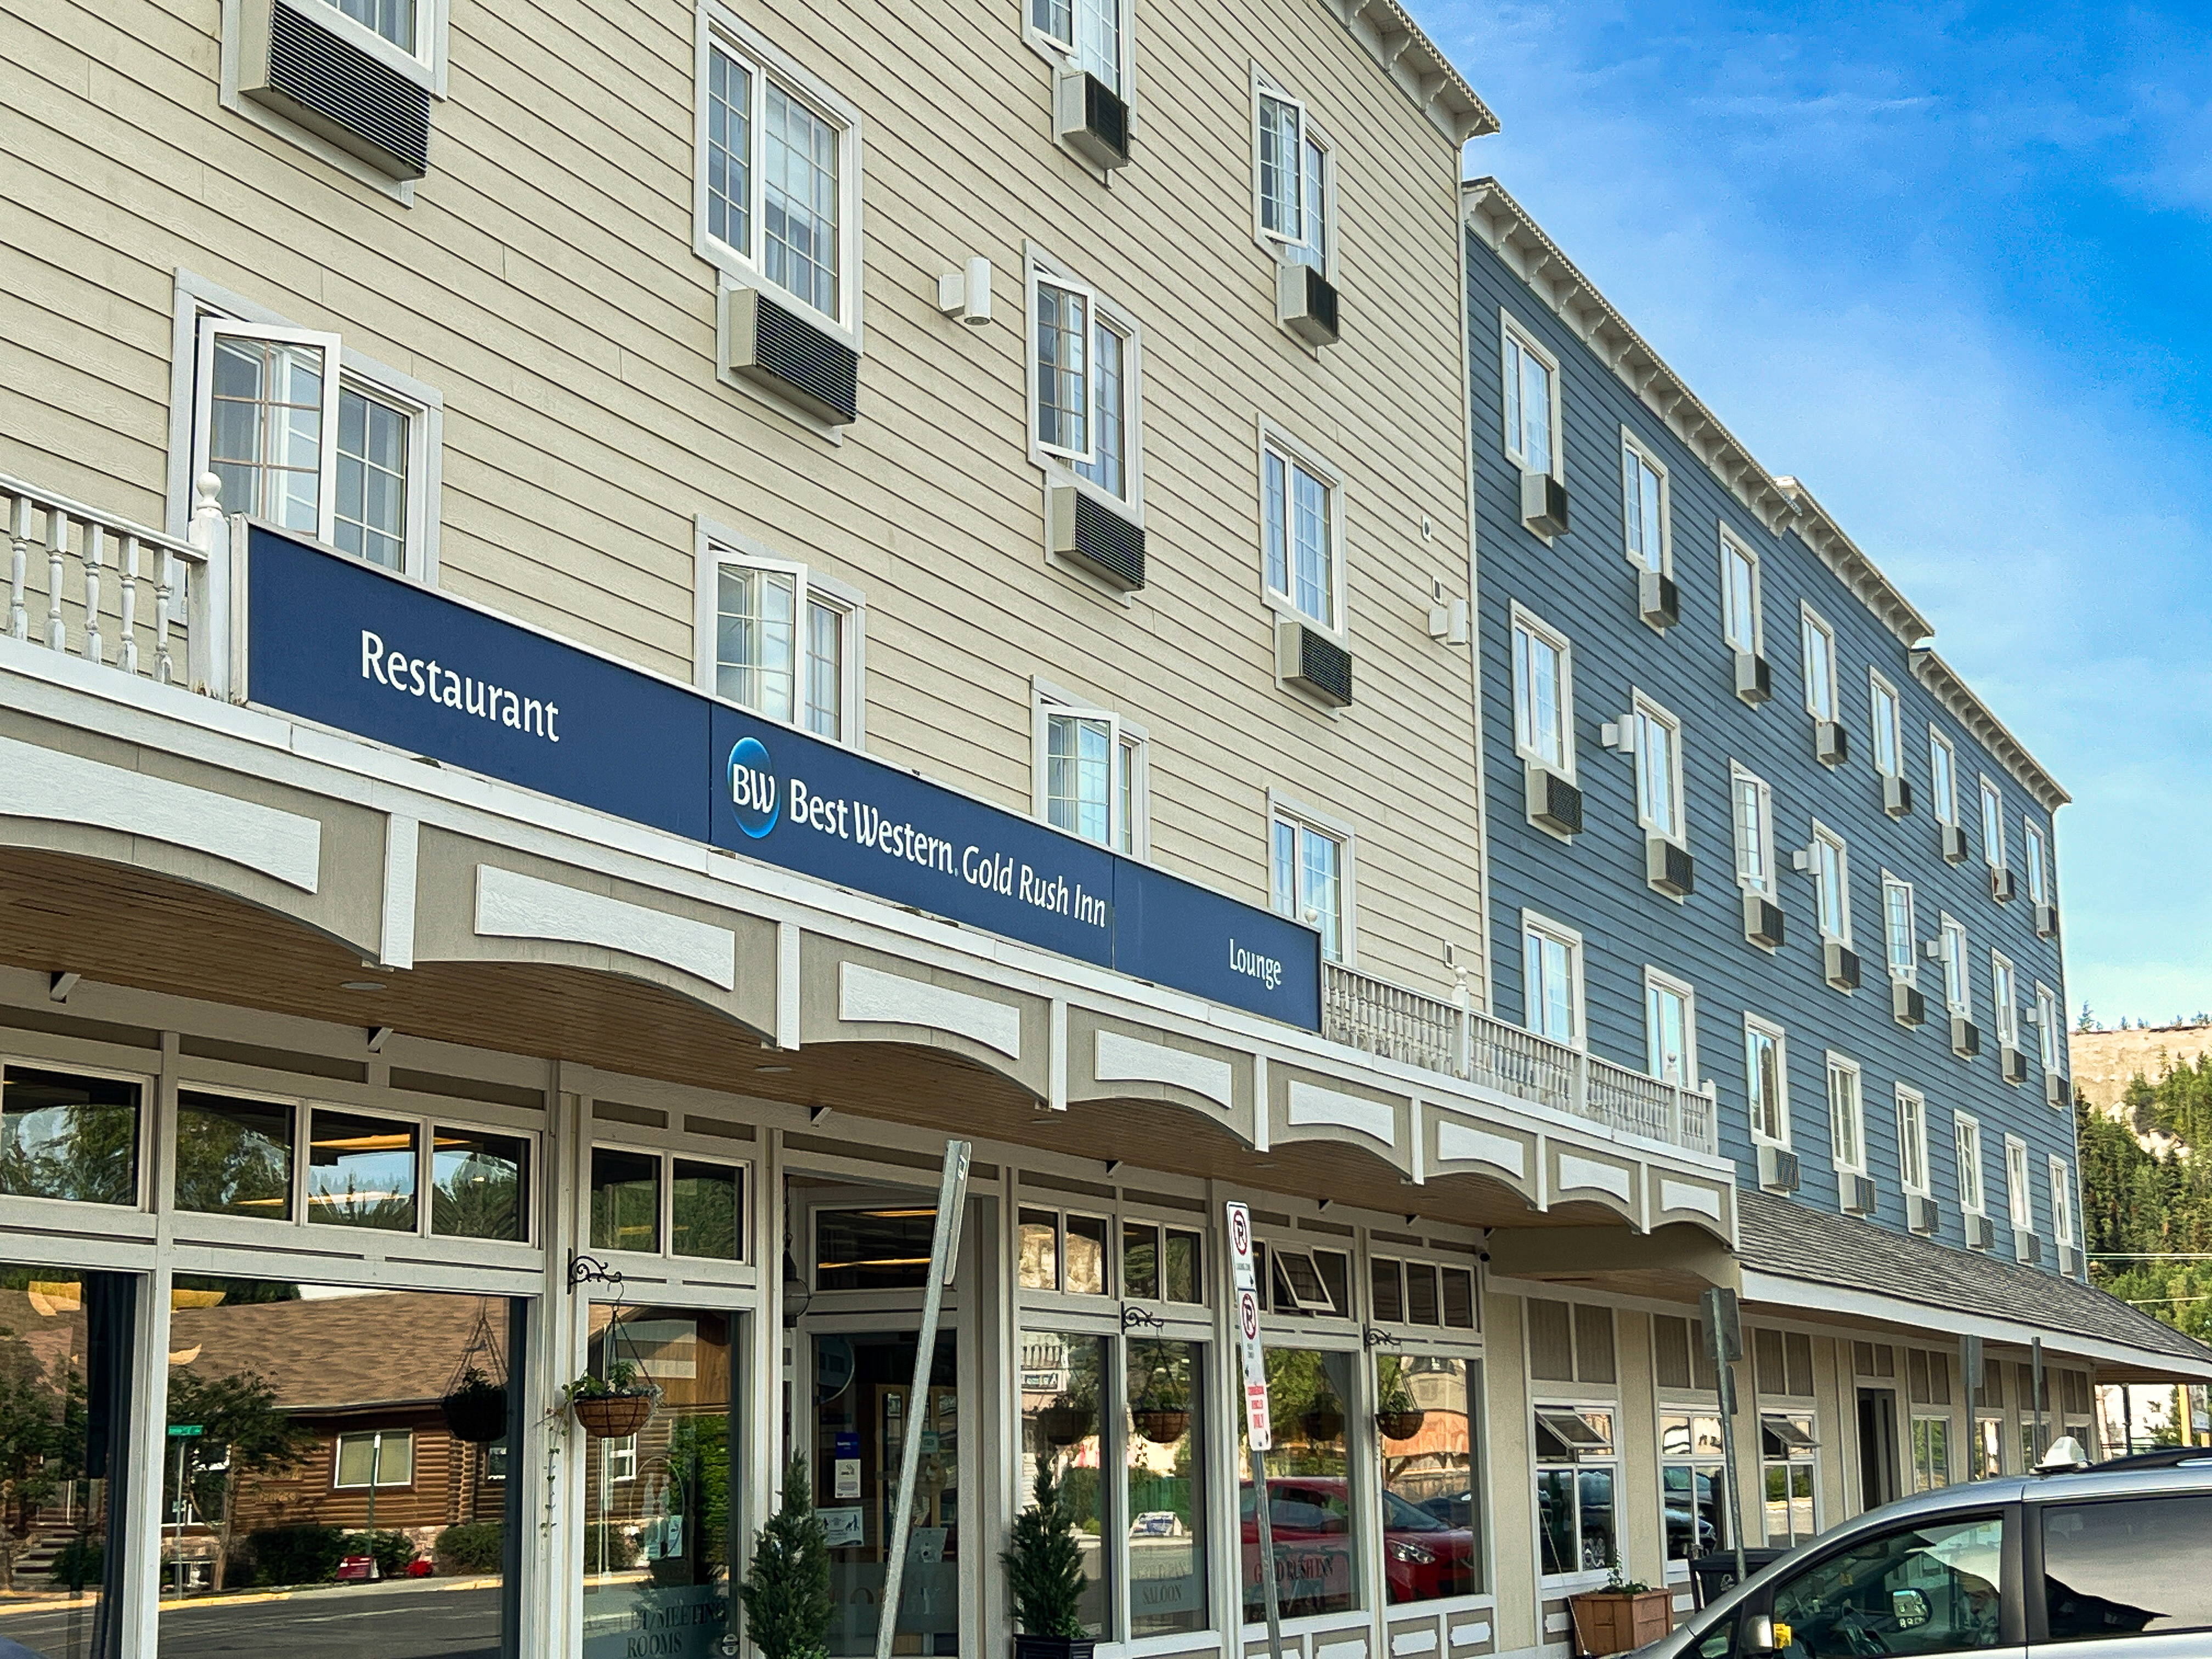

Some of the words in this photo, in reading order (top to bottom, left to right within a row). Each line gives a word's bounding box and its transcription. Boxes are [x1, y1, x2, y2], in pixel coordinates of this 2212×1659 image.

[362, 630, 560, 742] Restaurant
[733, 763, 776, 814] BW
[790, 778, 849, 839] Best
[963, 845, 1014, 896] Gold
[1019, 864, 1069, 916] Rush
[1074, 884, 1106, 928] Inn
[1229, 938, 1282, 990] Lounge
[1142, 1583, 1182, 1605] SALOON
[1254, 1560, 1284, 1584] GD
[627, 1632, 682, 1658] ROOMS
